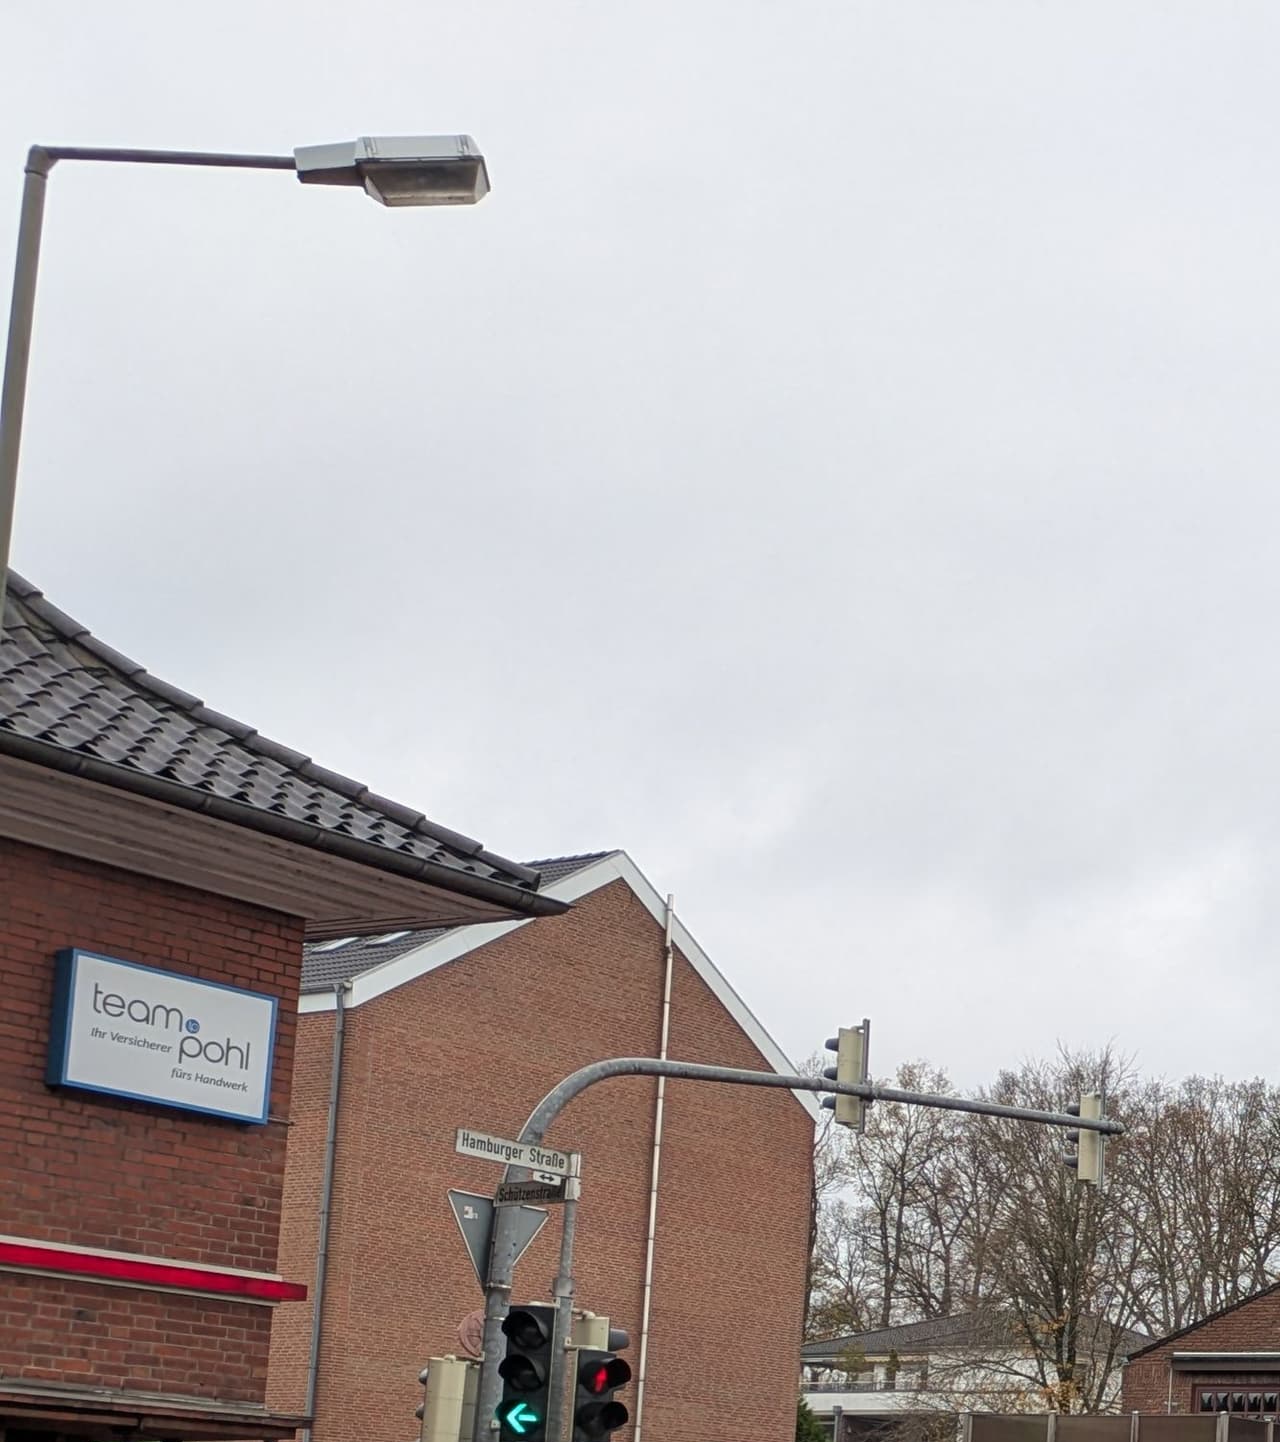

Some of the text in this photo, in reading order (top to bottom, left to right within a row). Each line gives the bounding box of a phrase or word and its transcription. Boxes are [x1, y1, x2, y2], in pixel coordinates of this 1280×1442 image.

[93, 982, 183, 1032] team
[91, 1027, 173, 1054] Ihr Versicherer
[178, 1035, 250, 1070] pohl
[170, 1066, 249, 1093] fürs Handwerk
[461, 1131, 565, 1169] Hamburger Straße
